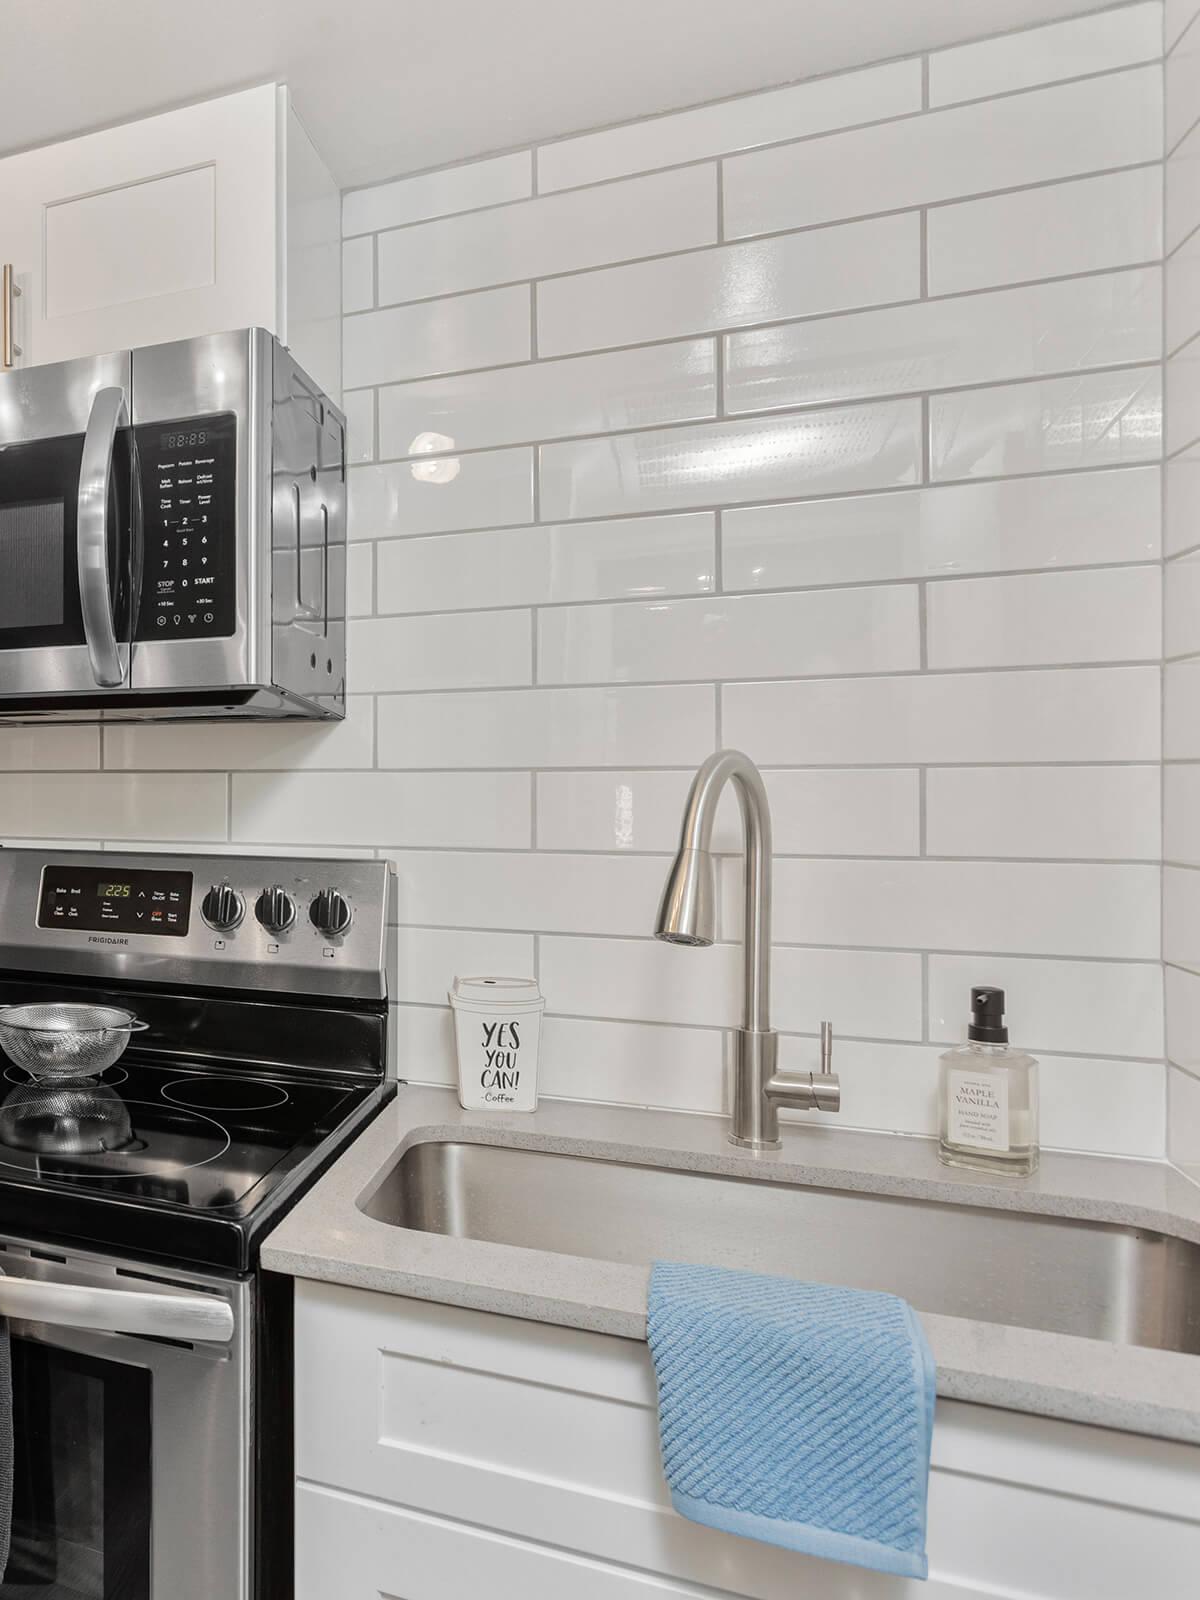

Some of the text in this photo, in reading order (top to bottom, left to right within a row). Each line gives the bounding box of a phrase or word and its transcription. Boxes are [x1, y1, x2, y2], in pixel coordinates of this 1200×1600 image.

[163, 515, 208, 527] 1 2 3
[162, 535, 208, 547] 4 5 6
[162, 556, 208, 568] 7 8 9
[157, 576, 215, 588] STOP 0 START
[87, 936, 129, 946] FRIGIDAIRE
[481, 1021, 520, 1050] YES
[484, 1049, 517, 1069] YOU
[480, 1068, 520, 1091] CAN!
[959, 1086, 996, 1099] MAPLE
[955, 1095, 1000, 1109] VANILLA
